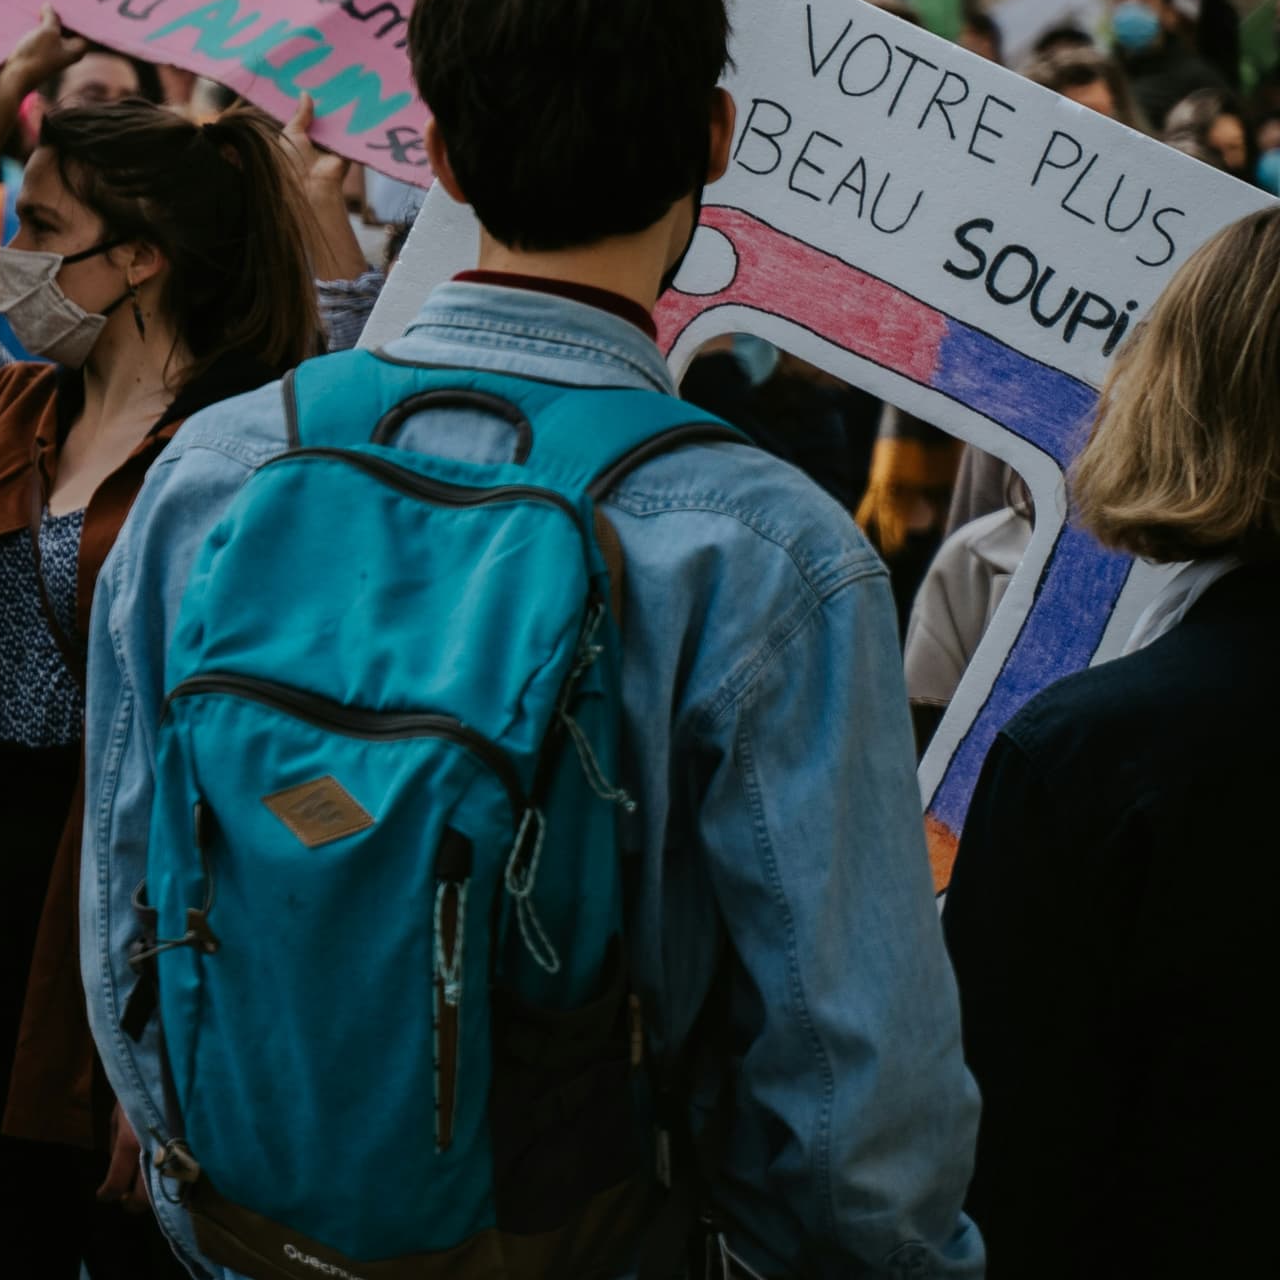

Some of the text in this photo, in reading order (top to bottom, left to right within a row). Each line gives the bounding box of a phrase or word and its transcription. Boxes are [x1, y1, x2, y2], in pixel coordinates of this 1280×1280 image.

[366, 126, 429, 167] se
[735, 99, 1139, 358] BEAU SOUPi
[806, 4, 1186, 266] VOTRE PLUS
